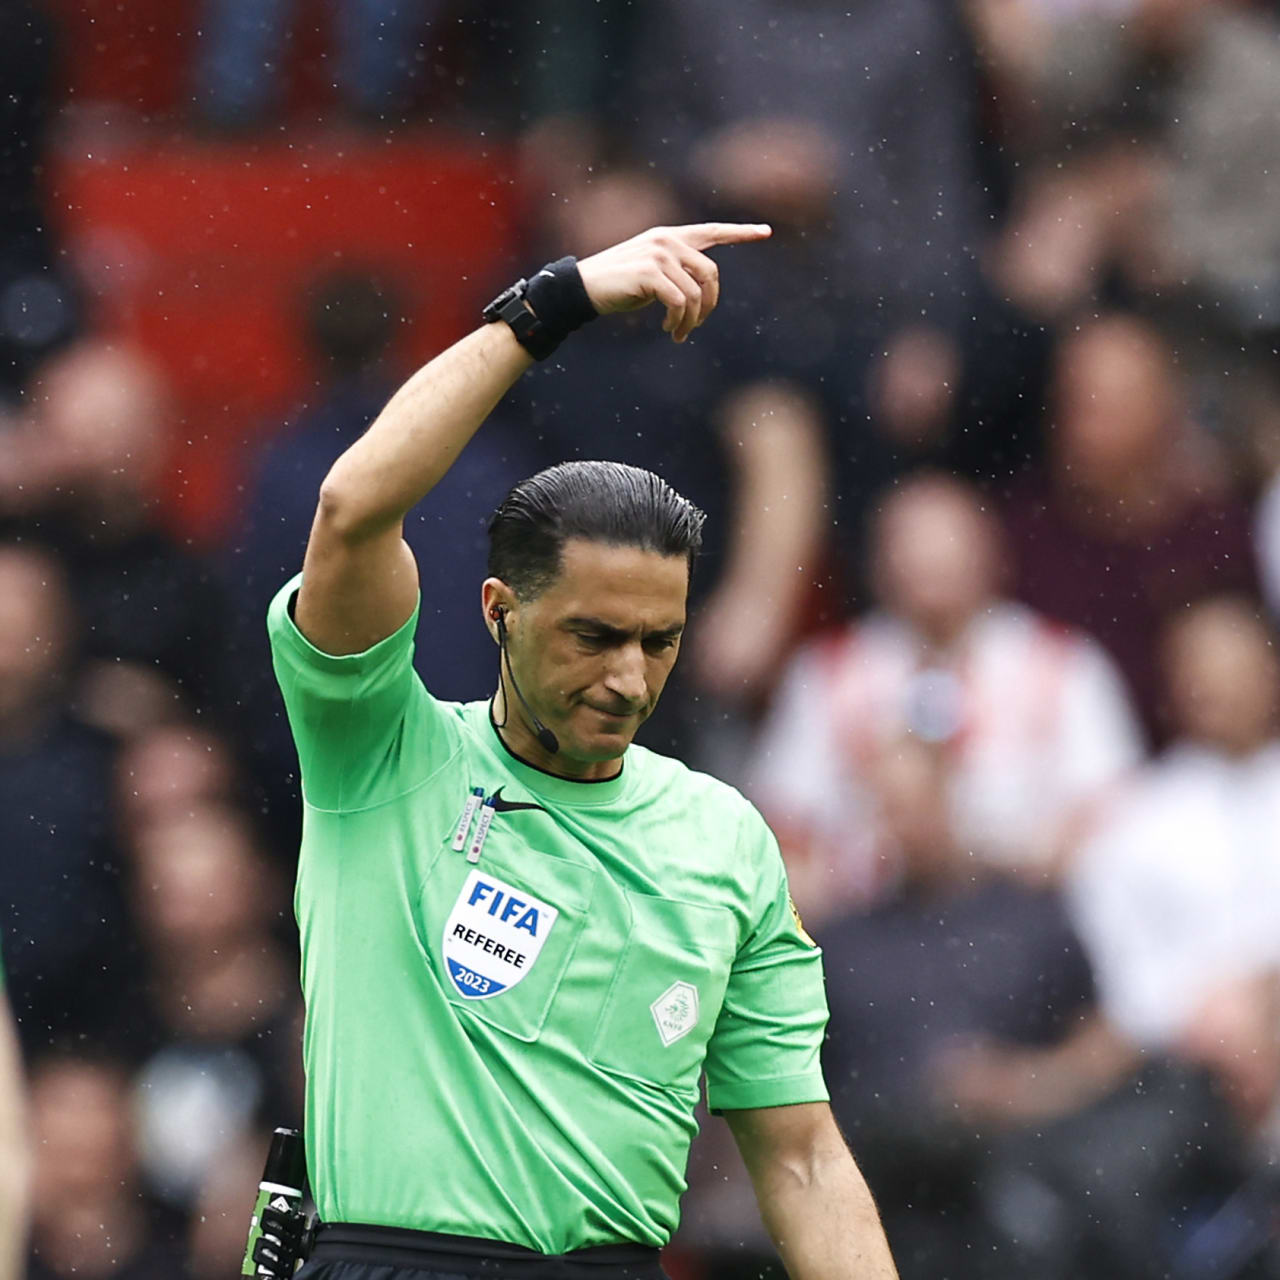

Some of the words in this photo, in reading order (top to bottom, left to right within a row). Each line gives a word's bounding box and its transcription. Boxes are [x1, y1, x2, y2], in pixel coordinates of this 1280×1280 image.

[468, 881, 540, 938] FIFA
[452, 923, 527, 969] REFEREE
[455, 967, 492, 994] 2023
